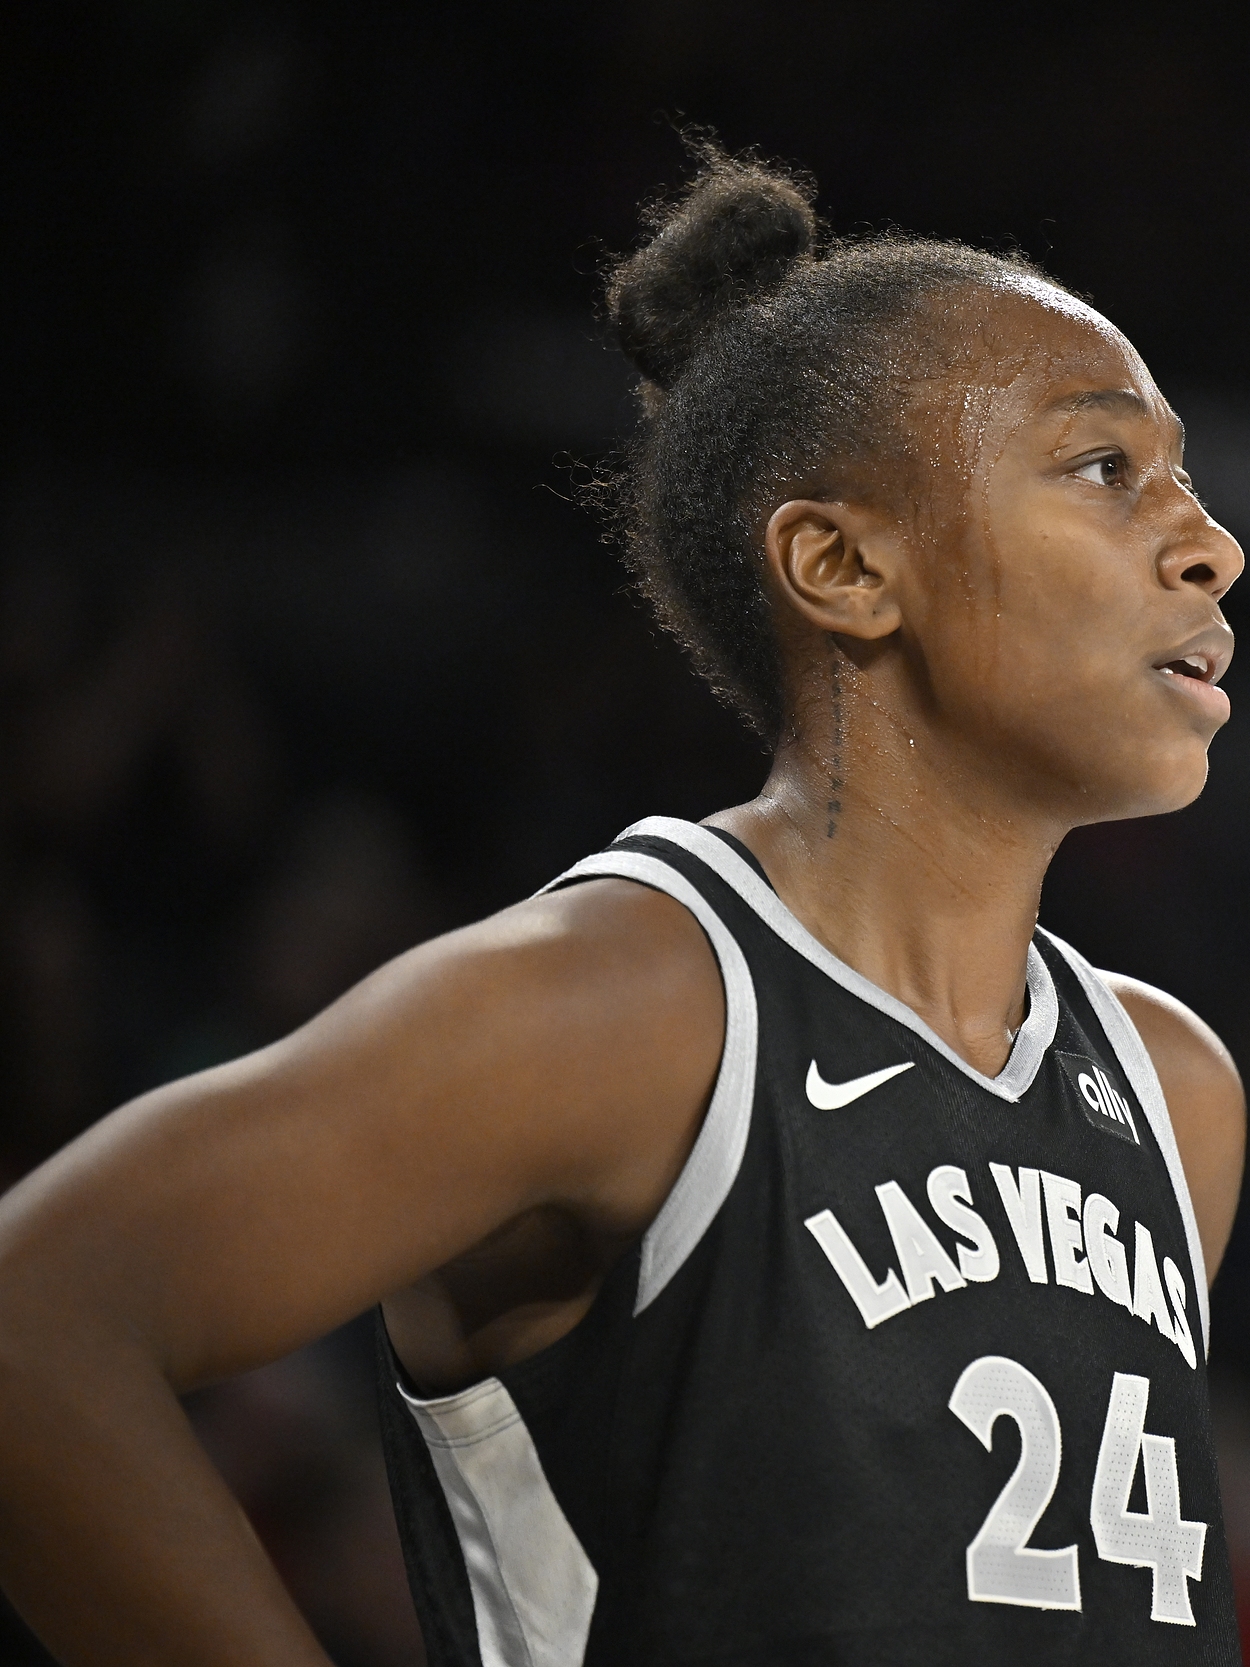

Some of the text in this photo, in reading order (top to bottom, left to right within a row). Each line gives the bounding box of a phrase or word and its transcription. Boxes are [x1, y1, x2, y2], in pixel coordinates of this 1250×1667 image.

[1078, 1065, 1140, 1145] ally
[804, 1162, 1197, 1370] LAS VEGAS
[948, 1356, 1208, 1627] 24
